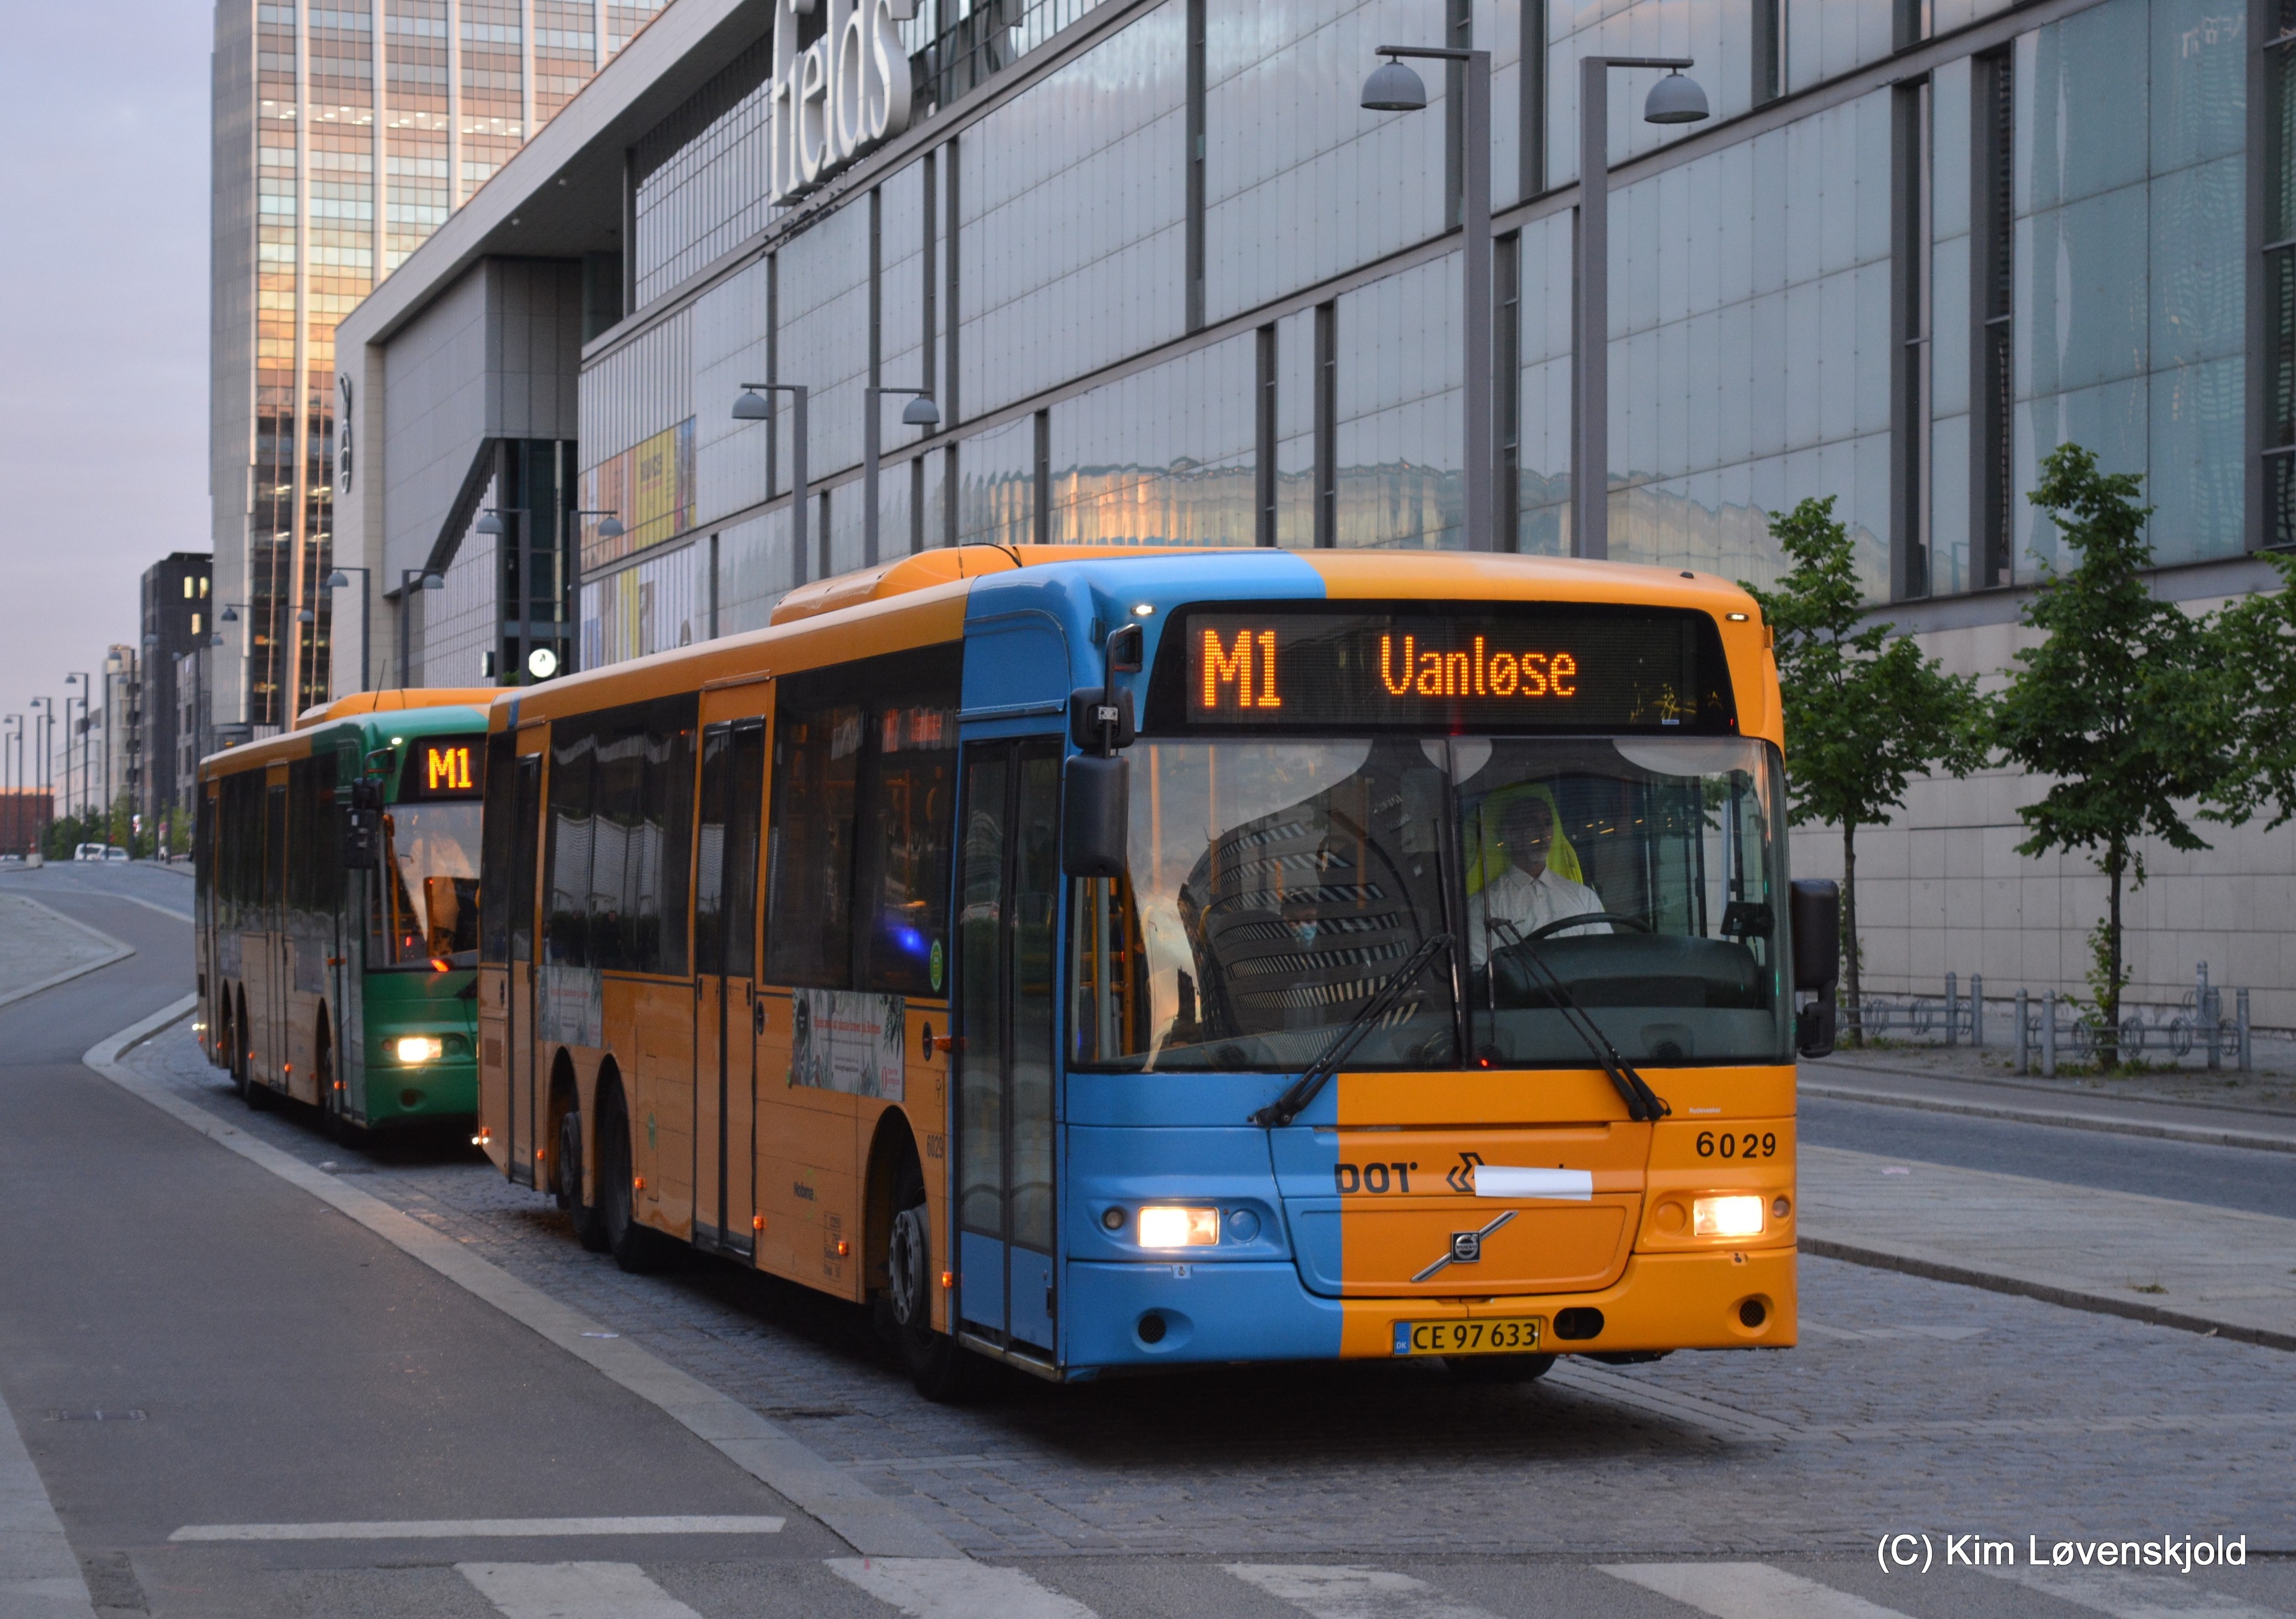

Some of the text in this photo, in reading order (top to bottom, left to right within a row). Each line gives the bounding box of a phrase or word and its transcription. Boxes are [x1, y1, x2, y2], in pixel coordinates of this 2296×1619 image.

[1204, 630, 1576, 706] M1 Vanløse
[428, 748, 473, 788] M1
[927, 1134, 944, 1159] 6029
[1696, 1131, 1776, 1159] 6029
[1334, 1161, 1418, 1193] DOT
[1396, 1341, 1407, 1350] DK
[1413, 1322, 1537, 1349] CE 97 633
